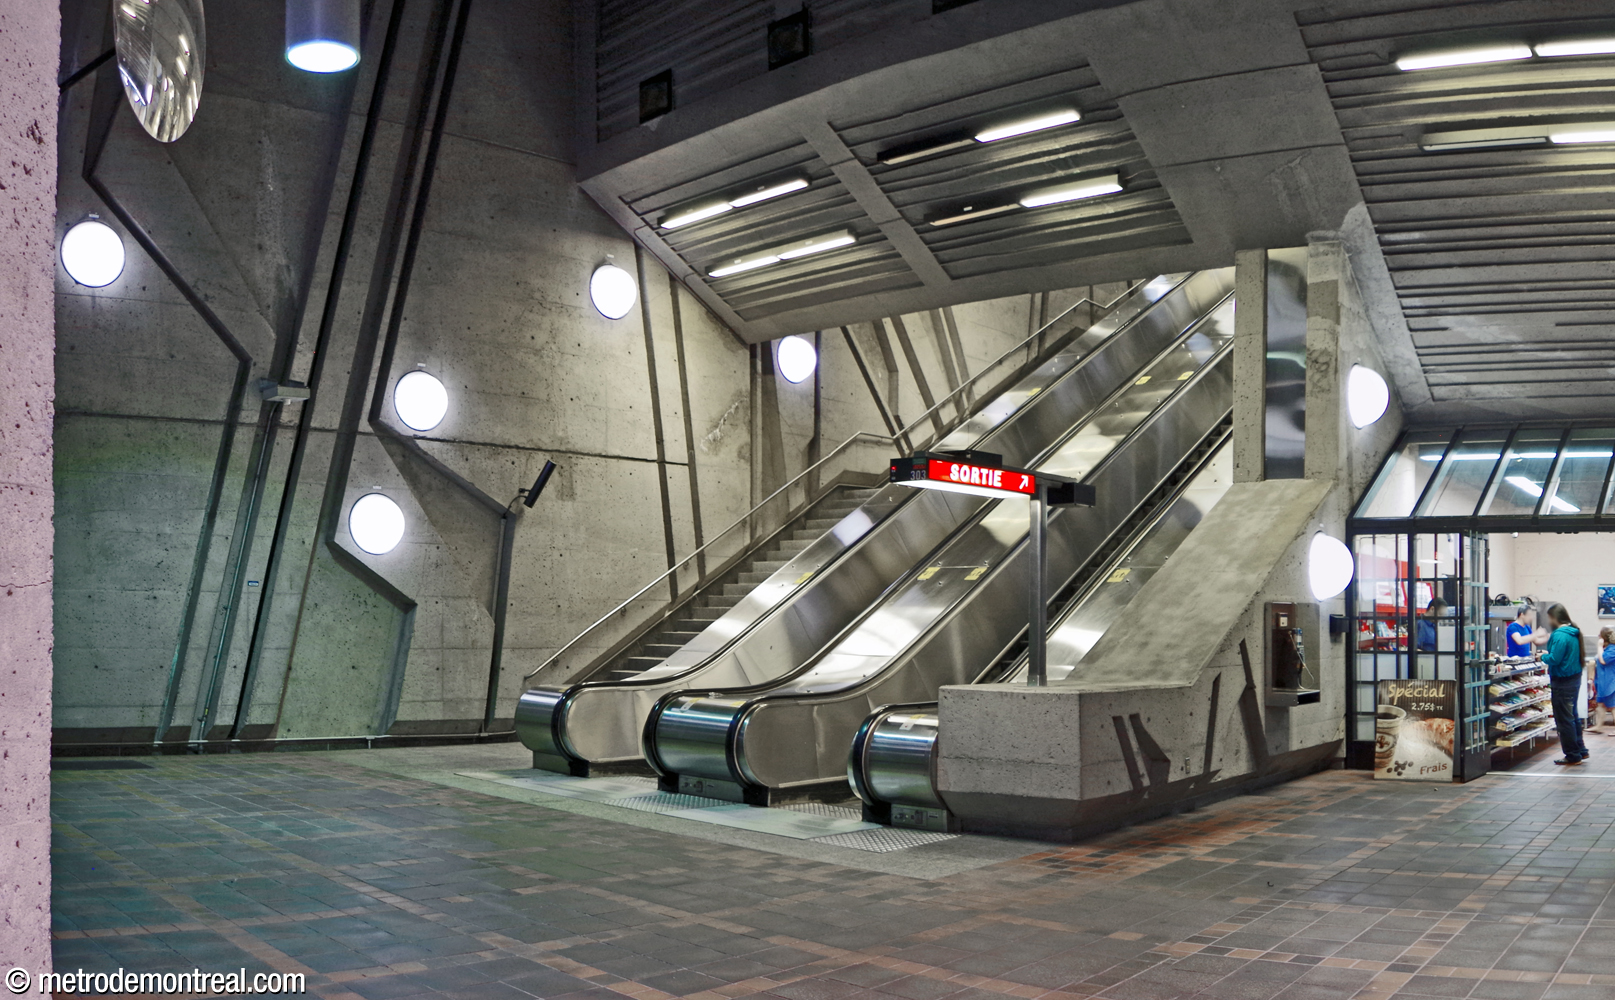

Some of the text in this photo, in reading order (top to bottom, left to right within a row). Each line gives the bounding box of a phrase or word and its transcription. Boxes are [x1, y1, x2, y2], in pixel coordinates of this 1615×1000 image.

[910, 469, 926, 480] 303
[950, 464, 1002, 487] SORTIE
[1388, 682, 1445, 705] Spécial
[1411, 702, 1435, 711] 2.75$
[1420, 762, 1447, 775] Frais
